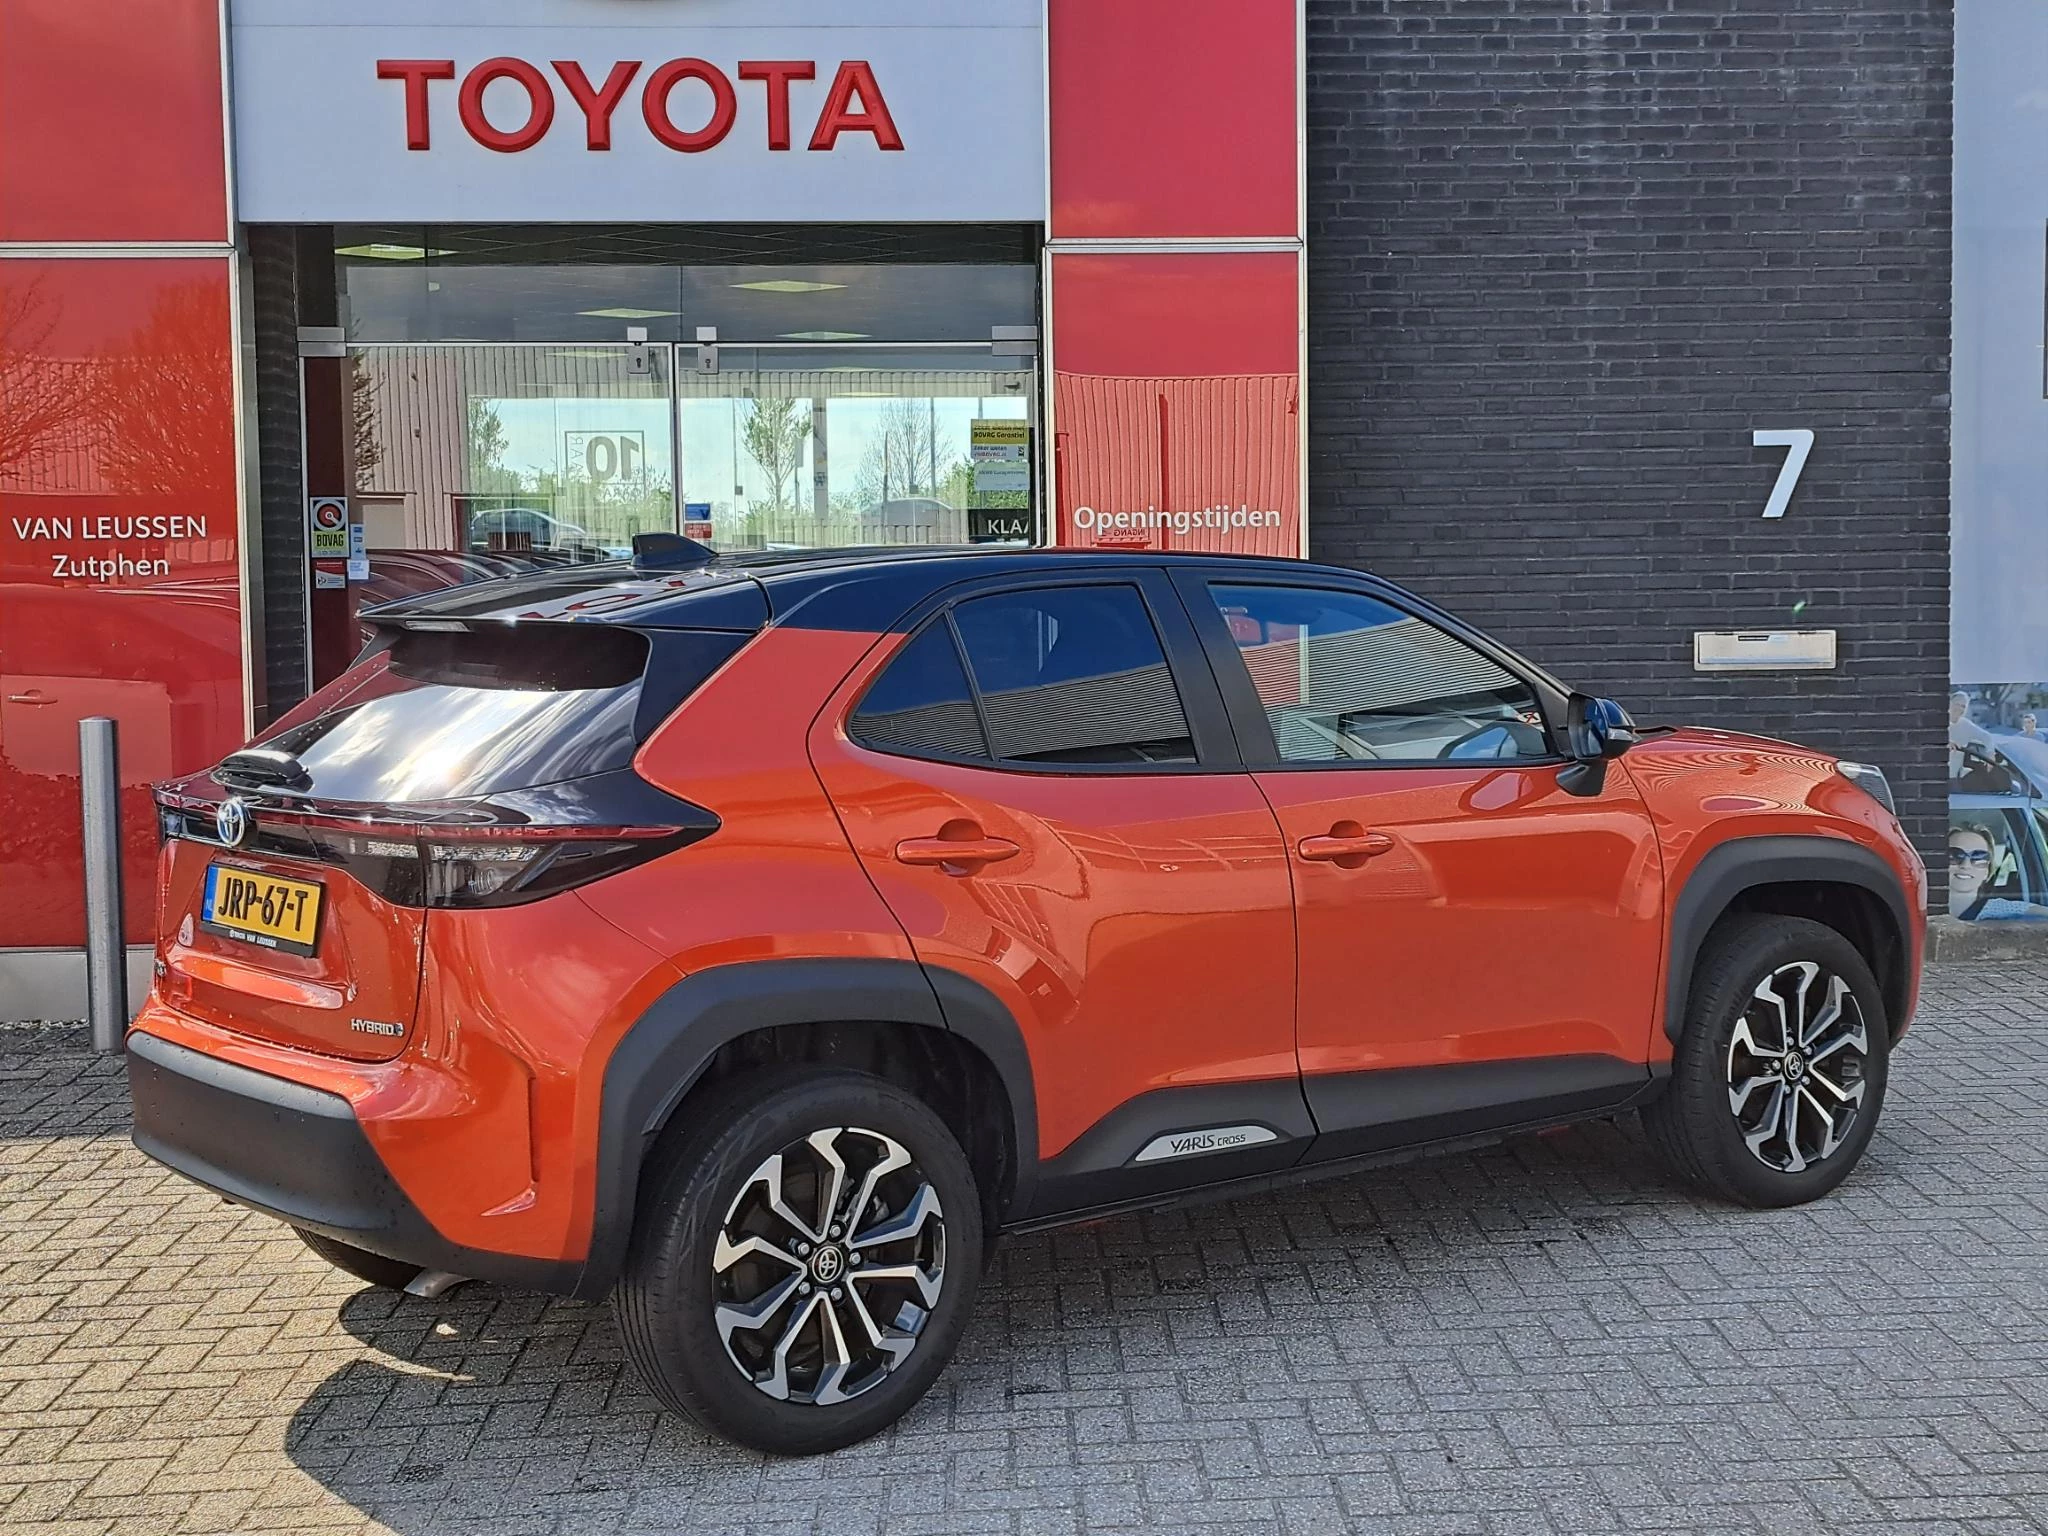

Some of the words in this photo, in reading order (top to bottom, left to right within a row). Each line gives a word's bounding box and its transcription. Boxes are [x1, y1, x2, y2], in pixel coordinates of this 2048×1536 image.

[377, 57, 904, 153] TOYOTA
[1753, 429, 1816, 519] 7
[12, 516, 73, 540] VAN
[82, 515, 207, 539] LEUSSEN
[1073, 504, 1281, 535] Openingstijden
[316, 533, 344, 547] BOVAG
[52, 553, 170, 581] Zutphen
[218, 877, 308, 932] JRP-67-T
[351, 1018, 394, 1036] HYBRID
[1171, 1134, 1215, 1153] YARIS
[1217, 1134, 1246, 1147] CROSS
